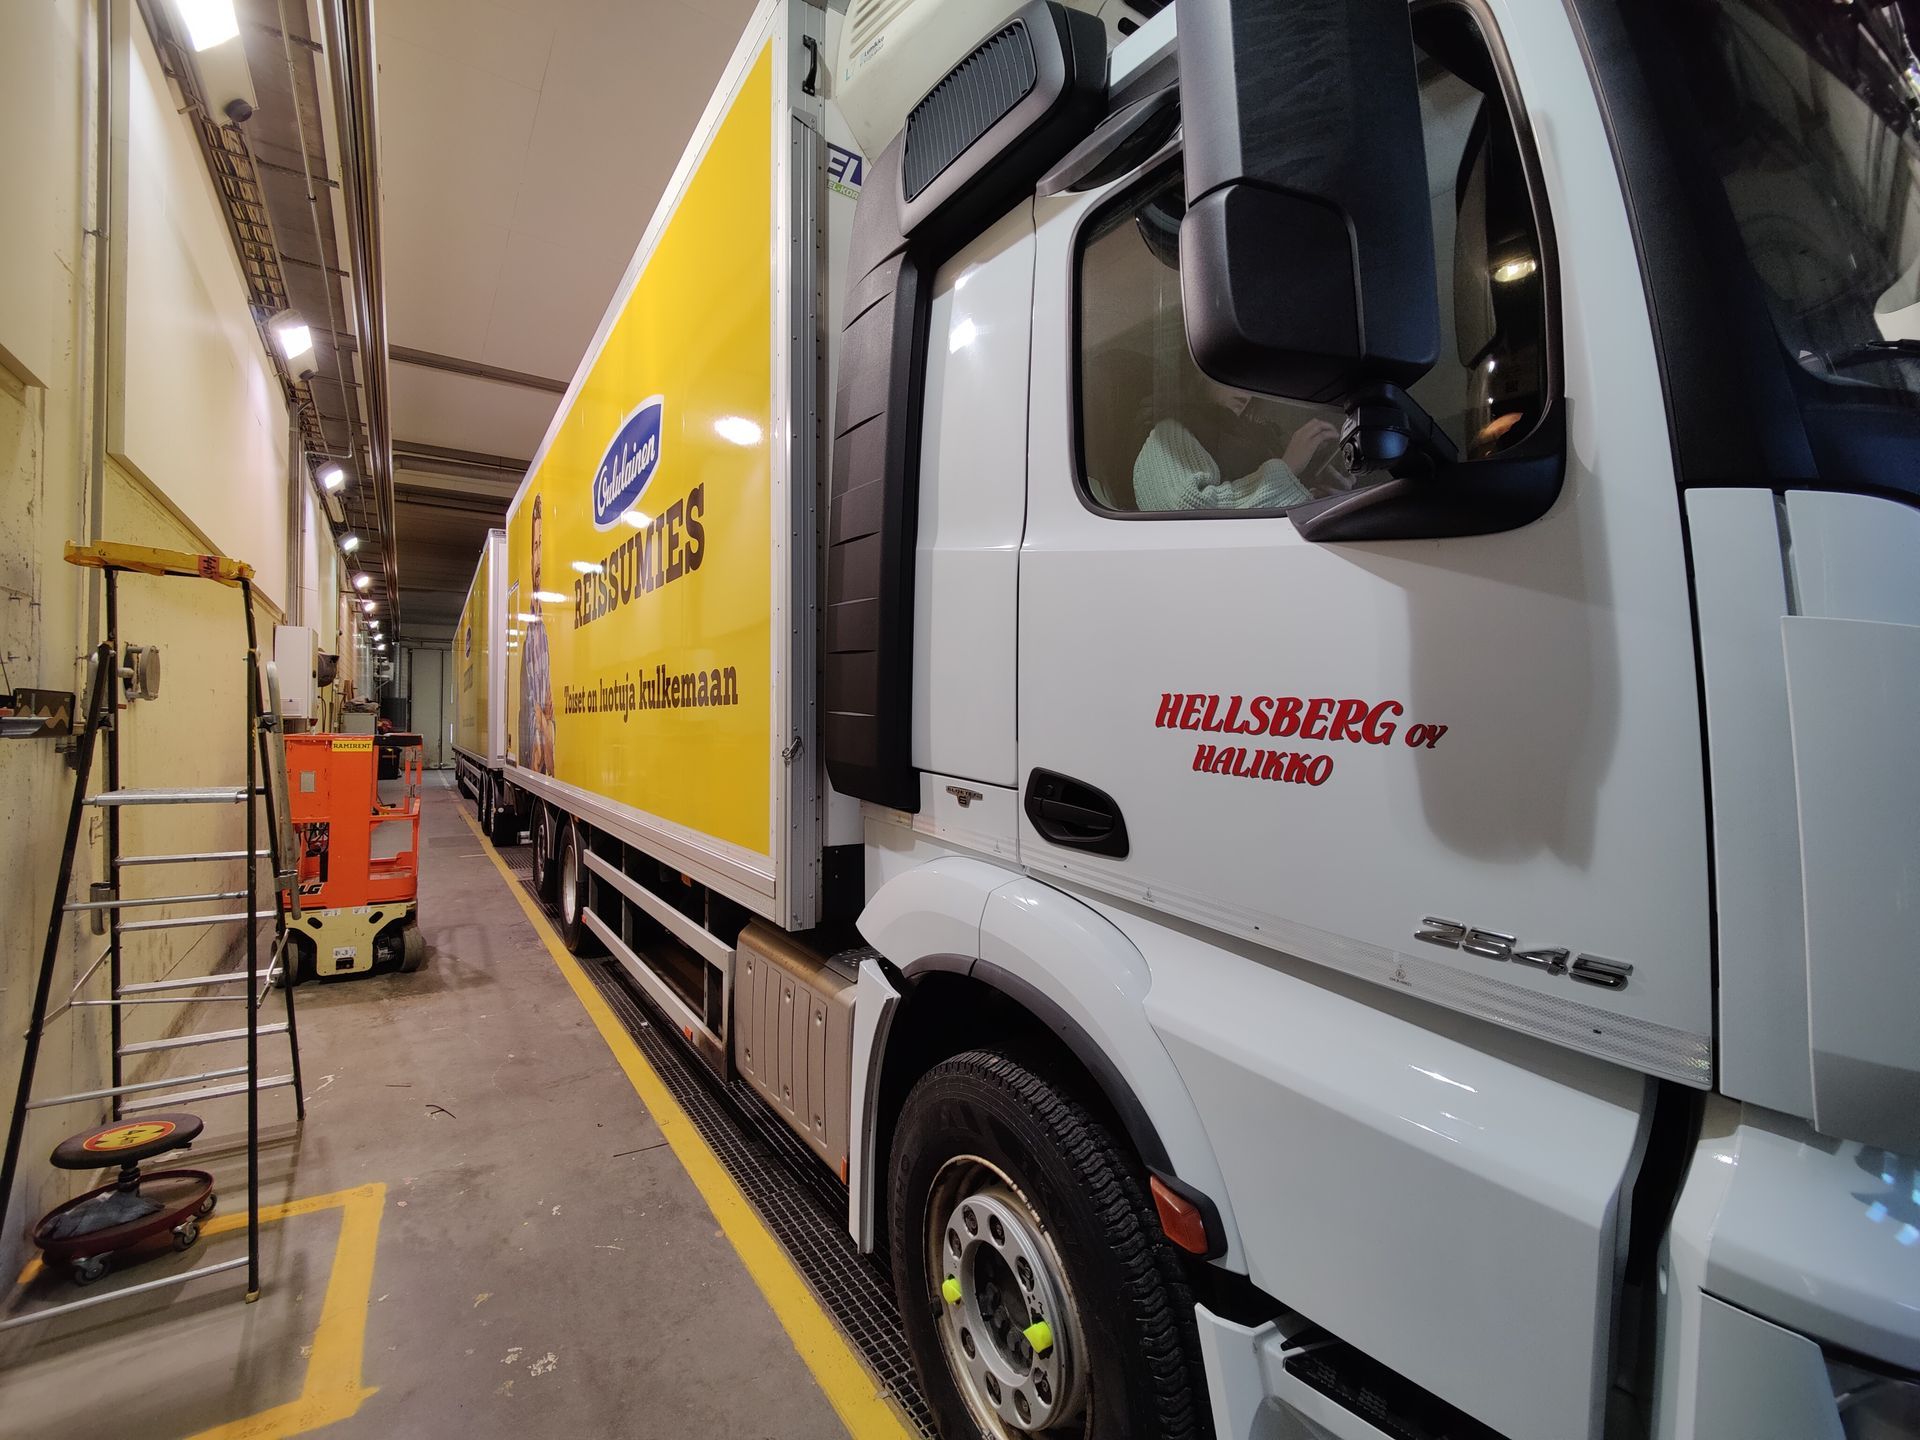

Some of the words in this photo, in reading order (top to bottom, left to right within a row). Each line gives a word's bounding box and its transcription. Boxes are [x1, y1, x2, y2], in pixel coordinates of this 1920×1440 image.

[597, 434, 656, 508] Oululainen
[574, 481, 706, 630] REISSUMIES
[564, 685, 586, 715] Toiset
[587, 688, 598, 713] on
[599, 672, 636, 724] luotuja
[638, 664, 739, 711] kulkemaan
[1154, 692, 1405, 746] HELLSBERG
[1404, 723, 1449, 749] OY
[1191, 744, 1335, 787] HALIKKO
[1413, 916, 1635, 992] 2545
